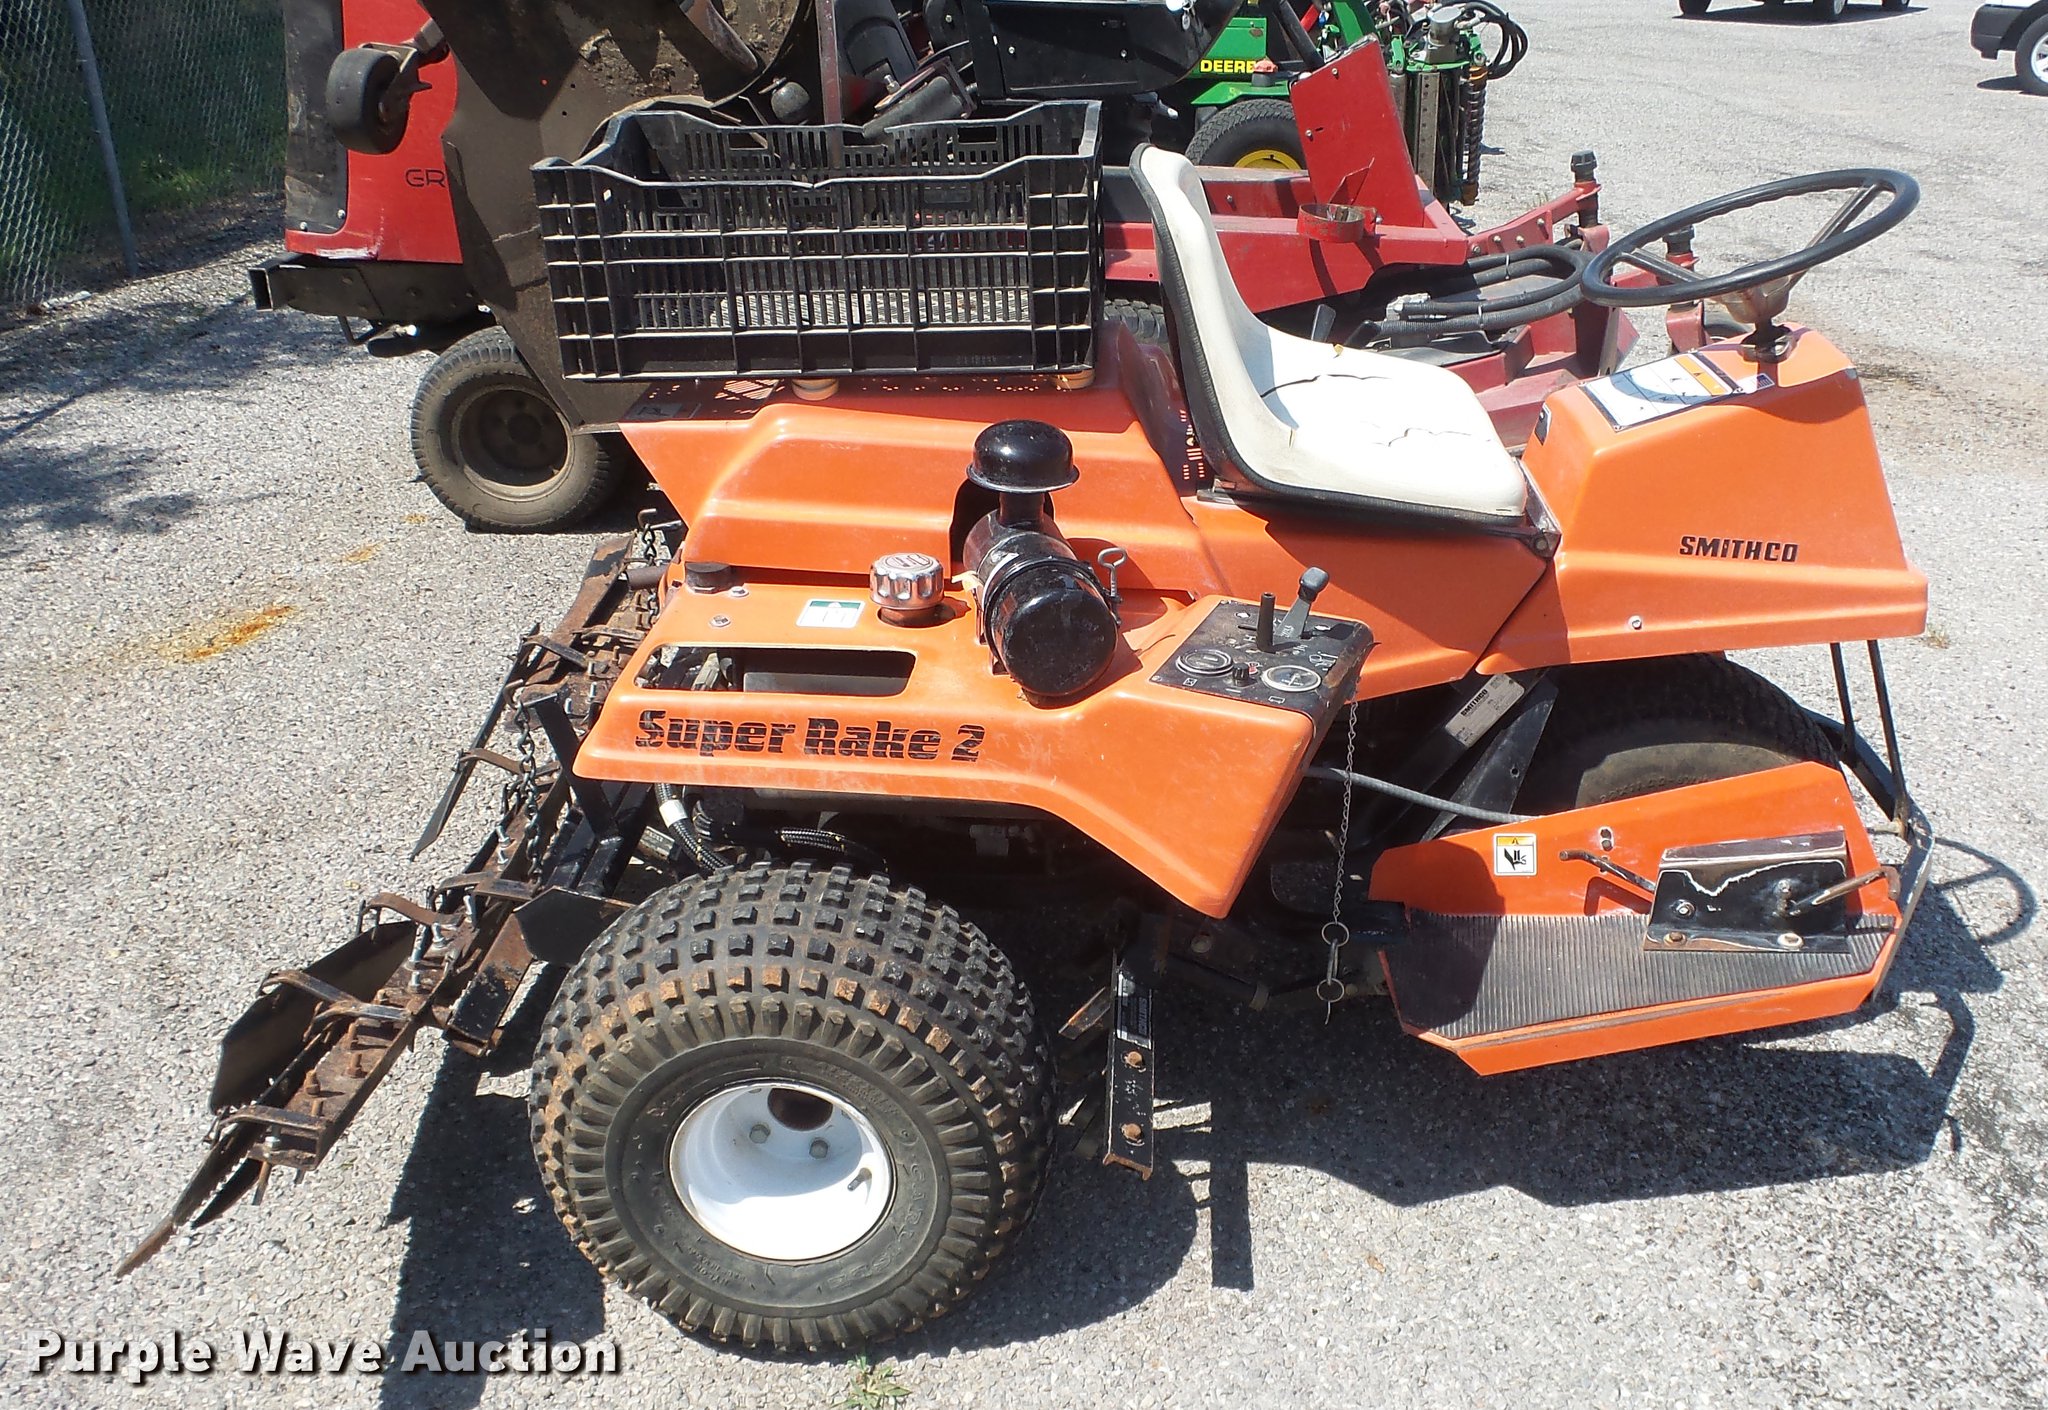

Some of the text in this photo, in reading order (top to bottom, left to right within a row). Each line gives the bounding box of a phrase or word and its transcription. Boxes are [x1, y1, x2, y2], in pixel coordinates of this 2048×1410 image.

[1200, 59, 1258, 74] DEERE
[1679, 535, 1799, 563] SMITHCO
[635, 710, 985, 762] Super Rake 2
